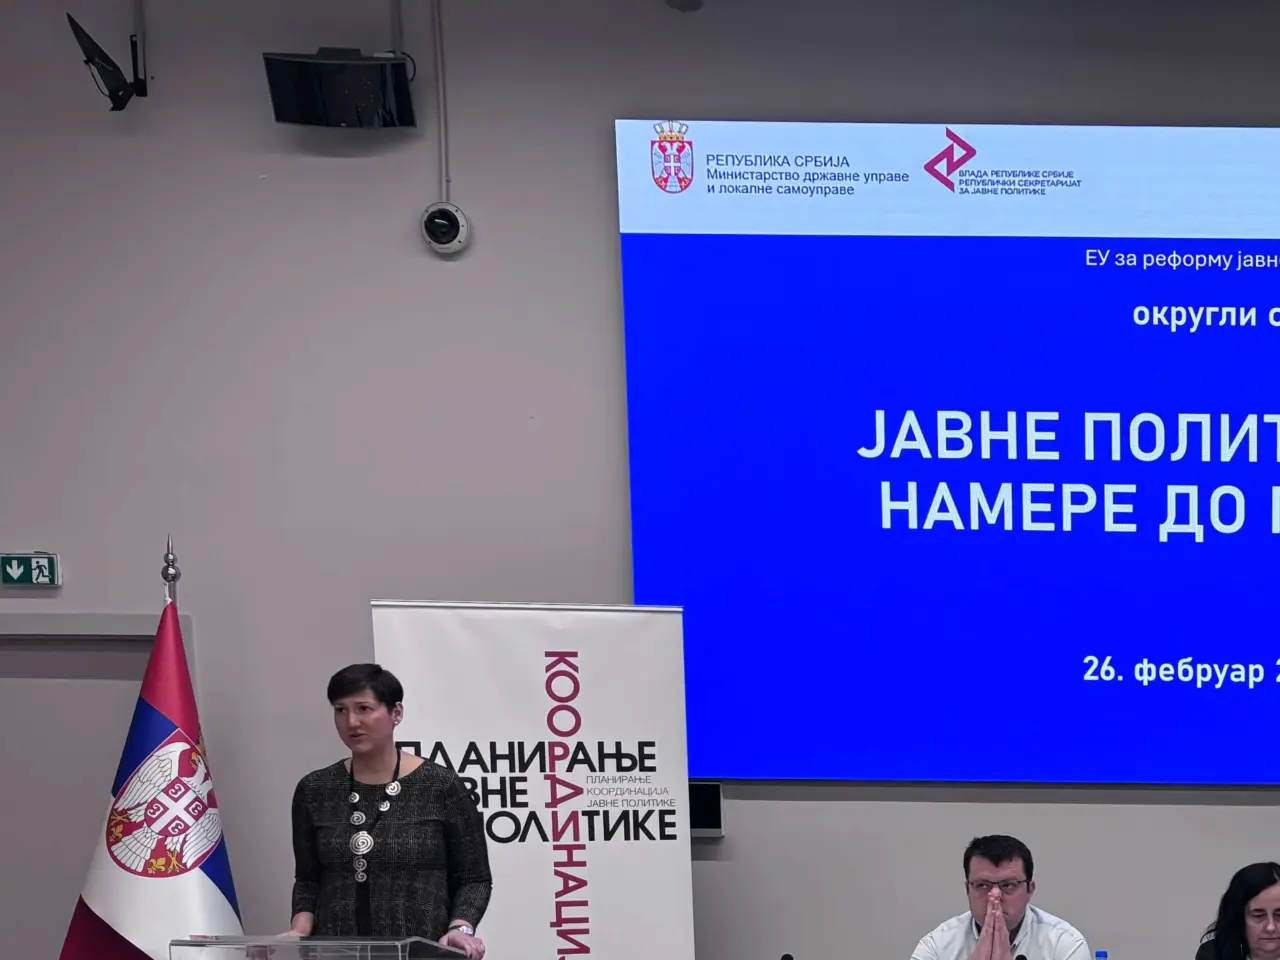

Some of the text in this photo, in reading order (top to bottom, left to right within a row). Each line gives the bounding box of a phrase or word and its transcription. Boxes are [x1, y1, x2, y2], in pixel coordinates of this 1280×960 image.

[706, 154, 850, 168] РЕПУБЛИКА СРБИЈА
[707, 168, 909, 184] Министарство државне управе
[959, 170, 988, 179] ВЛАДА
[990, 170, 1040, 178] РЕПУБЛИКЕ
[959, 179, 1082, 187] РЕПУБЛИЧКИ СЕКРЕТАРИЈАТ
[707, 184, 855, 197] и локалне самоуправе
[959, 187, 970, 195] ЗА
[971, 187, 999, 195] ЈАВНЕ
[1085, 249, 1111, 266] ЕУ
[1115, 253, 1137, 267] за
[1143, 250, 1233, 270] реформу
[1132, 305, 1257, 333] округли
[856, 409, 1060, 460] ЈАВНЕ
[881, 480, 1137, 532] НАМЕРЕ
[1159, 484, 1245, 543] ДО
[1083, 656, 1123, 681] 26.
[1134, 656, 1265, 689] фебруар
[586, 775, 652, 784] ПЛАНИРАЊЕ
[586, 787, 670, 796] КООРДИНАЦИЈА
[587, 798, 676, 808] ЈАВНЕ ПОЛИТИКЕ
[482, 809, 677, 843] ОЛИТИКЕ
